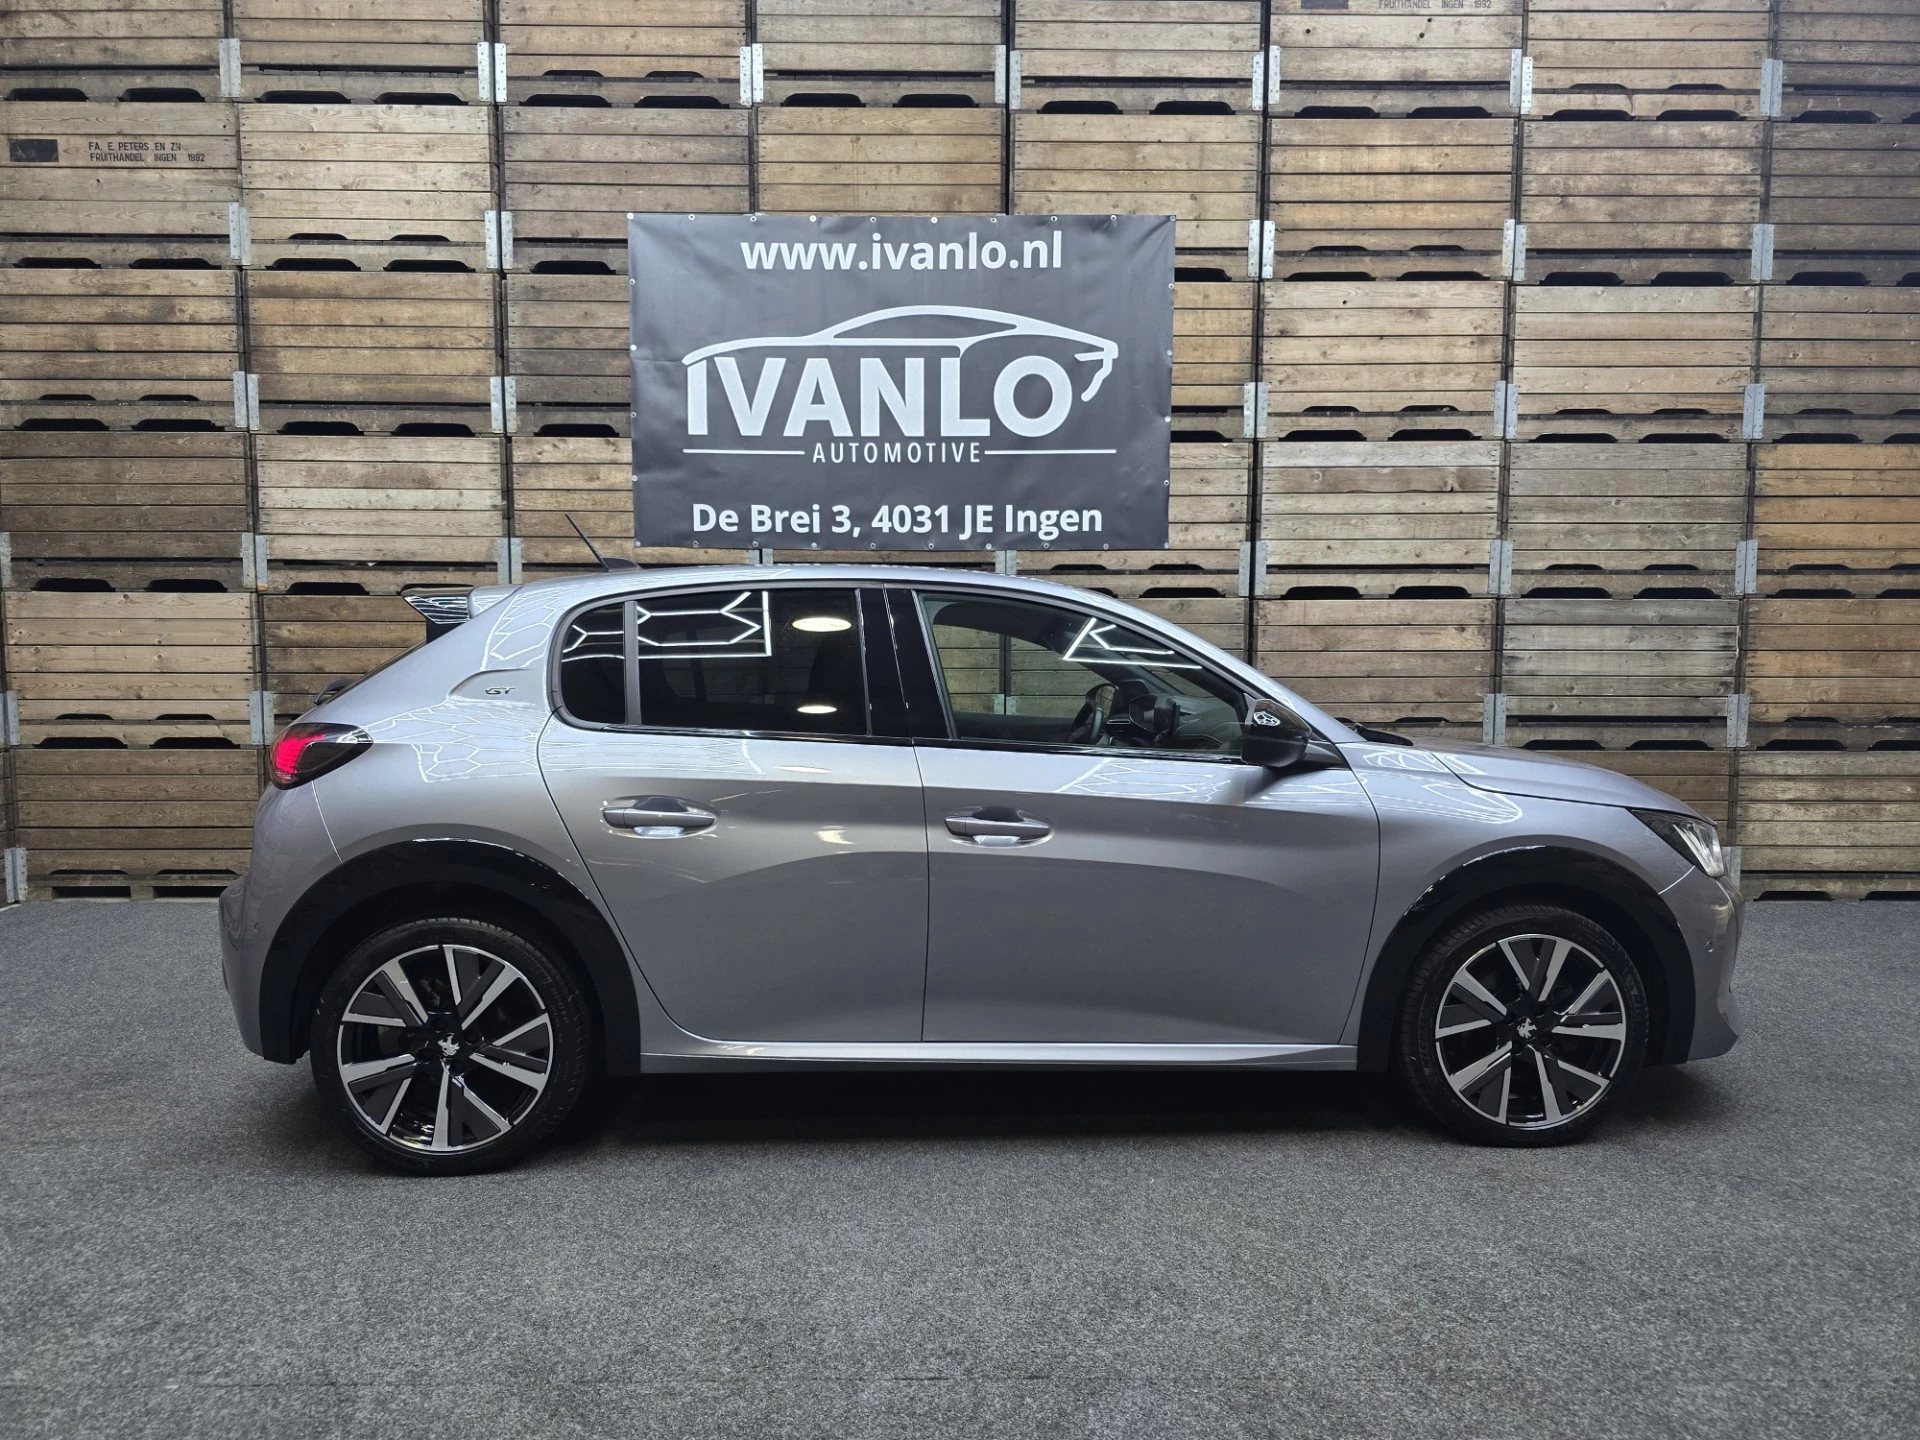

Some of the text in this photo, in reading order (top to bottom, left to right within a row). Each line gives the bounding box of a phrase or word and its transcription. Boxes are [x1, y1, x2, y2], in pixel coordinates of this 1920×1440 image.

[90, 153, 205, 162] FRUITHANDEL INGEN 1992
[118, 142, 149, 151] PETERS
[154, 142, 166, 151] EN
[740, 231, 1063, 271] www.ivanlo.nl
[686, 355, 1073, 438] IVANLO
[812, 442, 980, 464] AUTOMOTIVE
[692, 504, 1102, 541] De Brei 3, 4031 JE Ingen
[485, 687, 517, 695] GT
